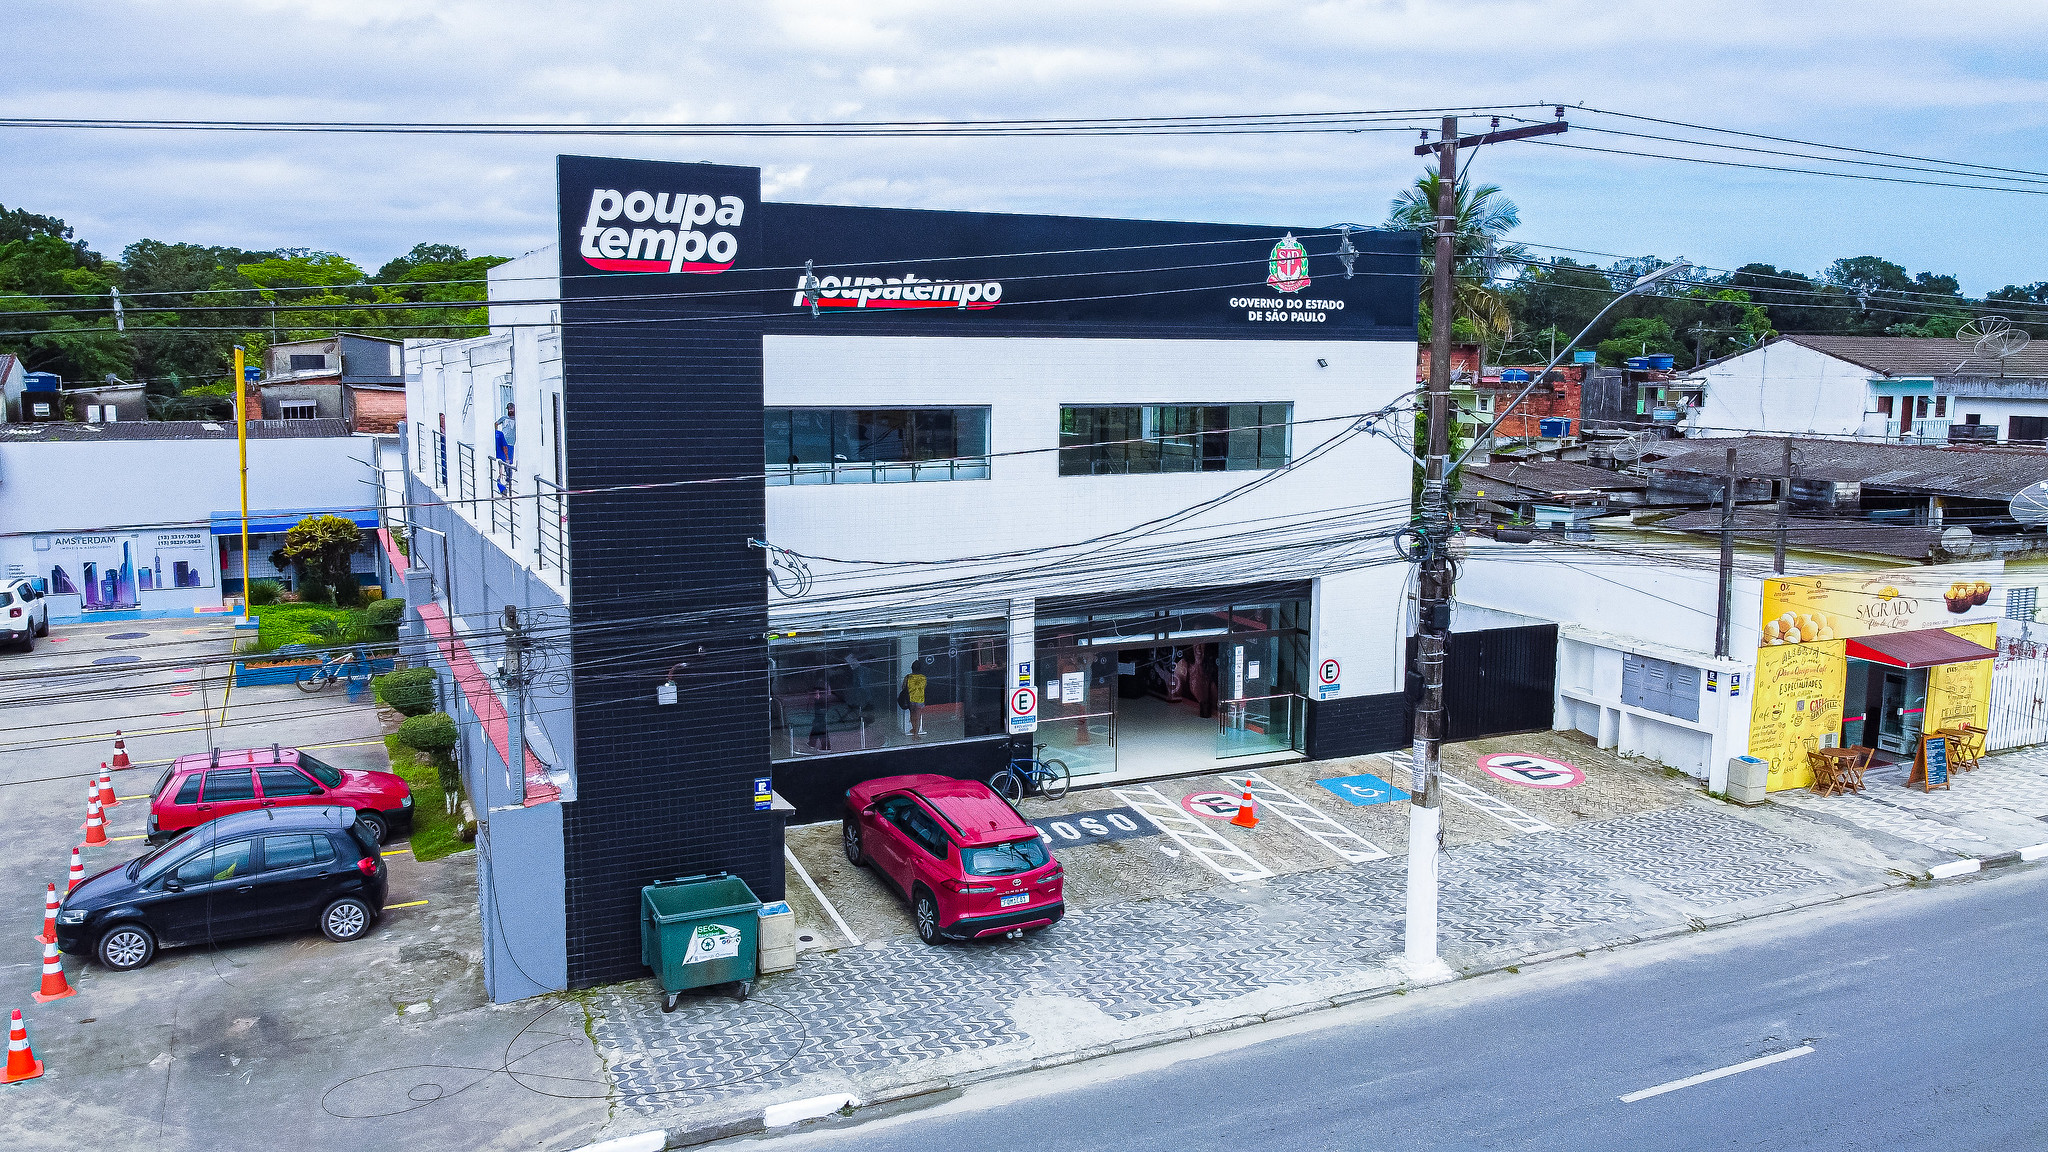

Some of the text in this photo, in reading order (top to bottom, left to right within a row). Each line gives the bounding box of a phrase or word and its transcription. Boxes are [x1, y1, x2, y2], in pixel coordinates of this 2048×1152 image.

[587, 188, 744, 230] poupa
[580, 227, 738, 273] tempo
[793, 274, 1003, 310] poupatempo
[1230, 298, 1344, 310] GOVERNO DO ESTADO
[1248, 309, 1326, 322] DE SÃO PAULO
[55, 536, 116, 545] AMSTERDAM
[1856, 600, 1918, 619] SAGRADO
[1326, 664, 1333, 679] E
[1018, 694, 1028, 710] E
